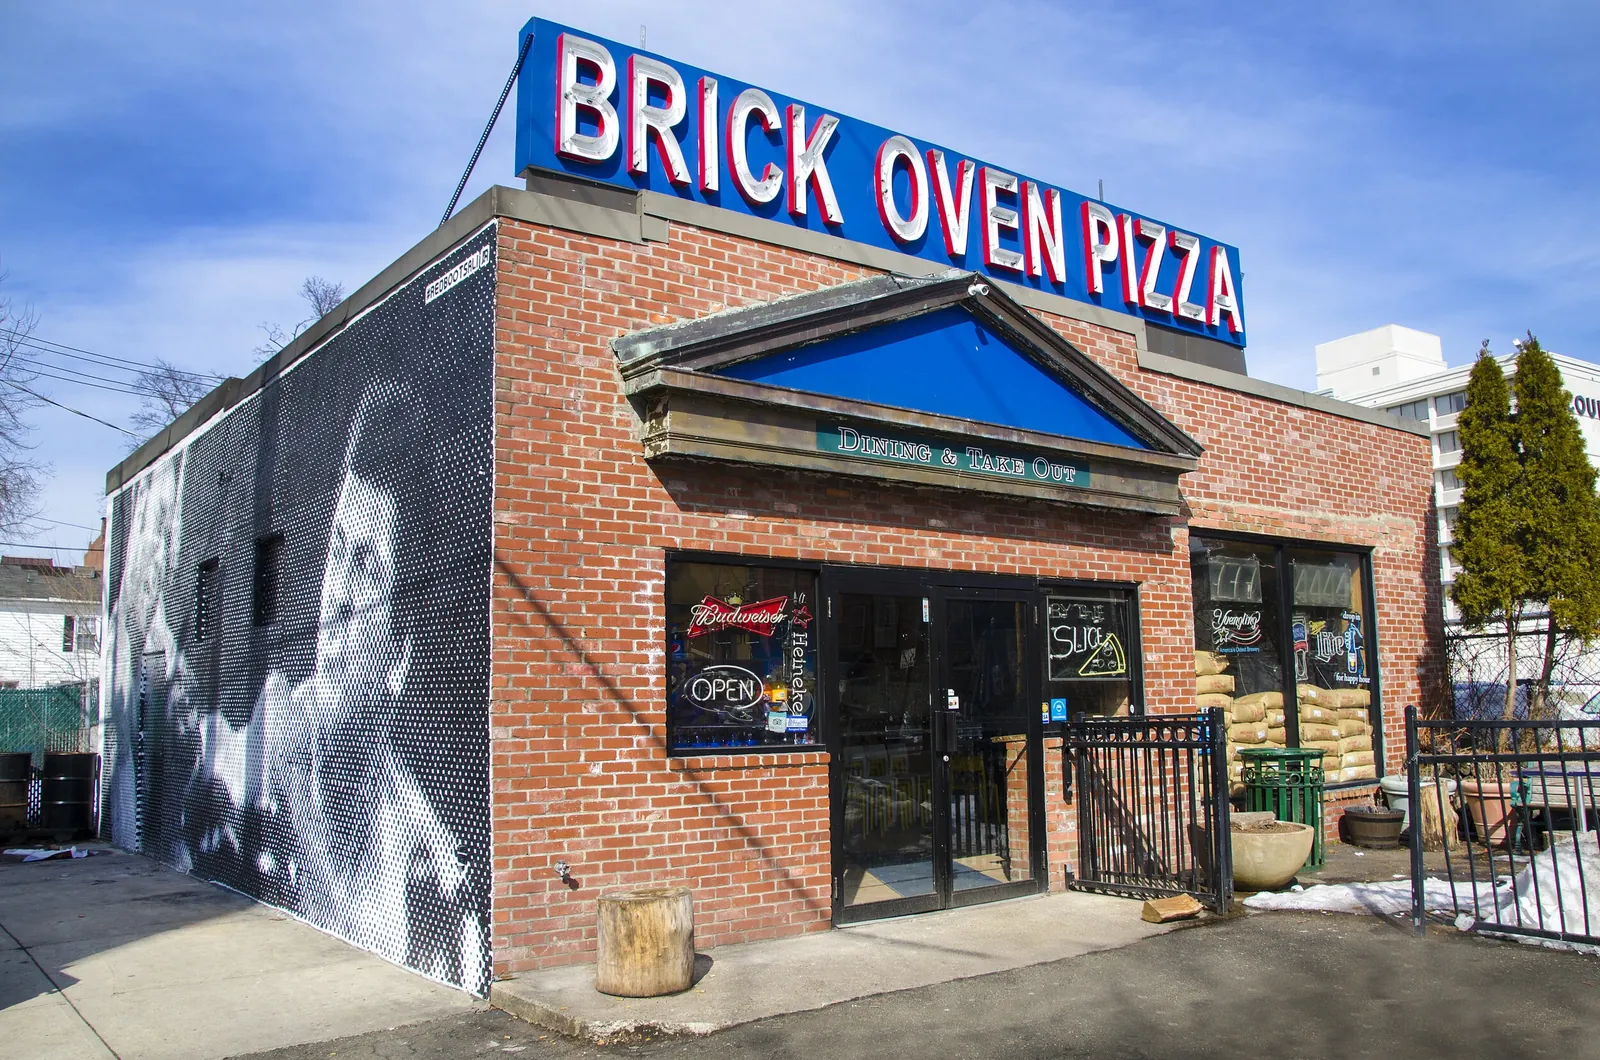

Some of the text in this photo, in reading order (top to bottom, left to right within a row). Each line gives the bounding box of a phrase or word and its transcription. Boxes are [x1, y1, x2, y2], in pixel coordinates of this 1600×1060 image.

[555, 32, 1243, 334] BRICK OVEN PIZZA
[838, 426, 1076, 483] DINING & TAKE OUT
[690, 604, 788, 626] Budweiser
[1050, 603, 1104, 621] BY THE
[1212, 608, 1261, 630] Yuengling
[1342, 611, 1355, 622] drop
[1050, 625, 1103, 658] SLICE
[1315, 632, 1345, 663] Lite
[792, 632, 808, 716] Heineke
[1344, 672, 1359, 684] happy
[1358, 674, 1371, 683] hour
[692, 678, 754, 702] OPEN
